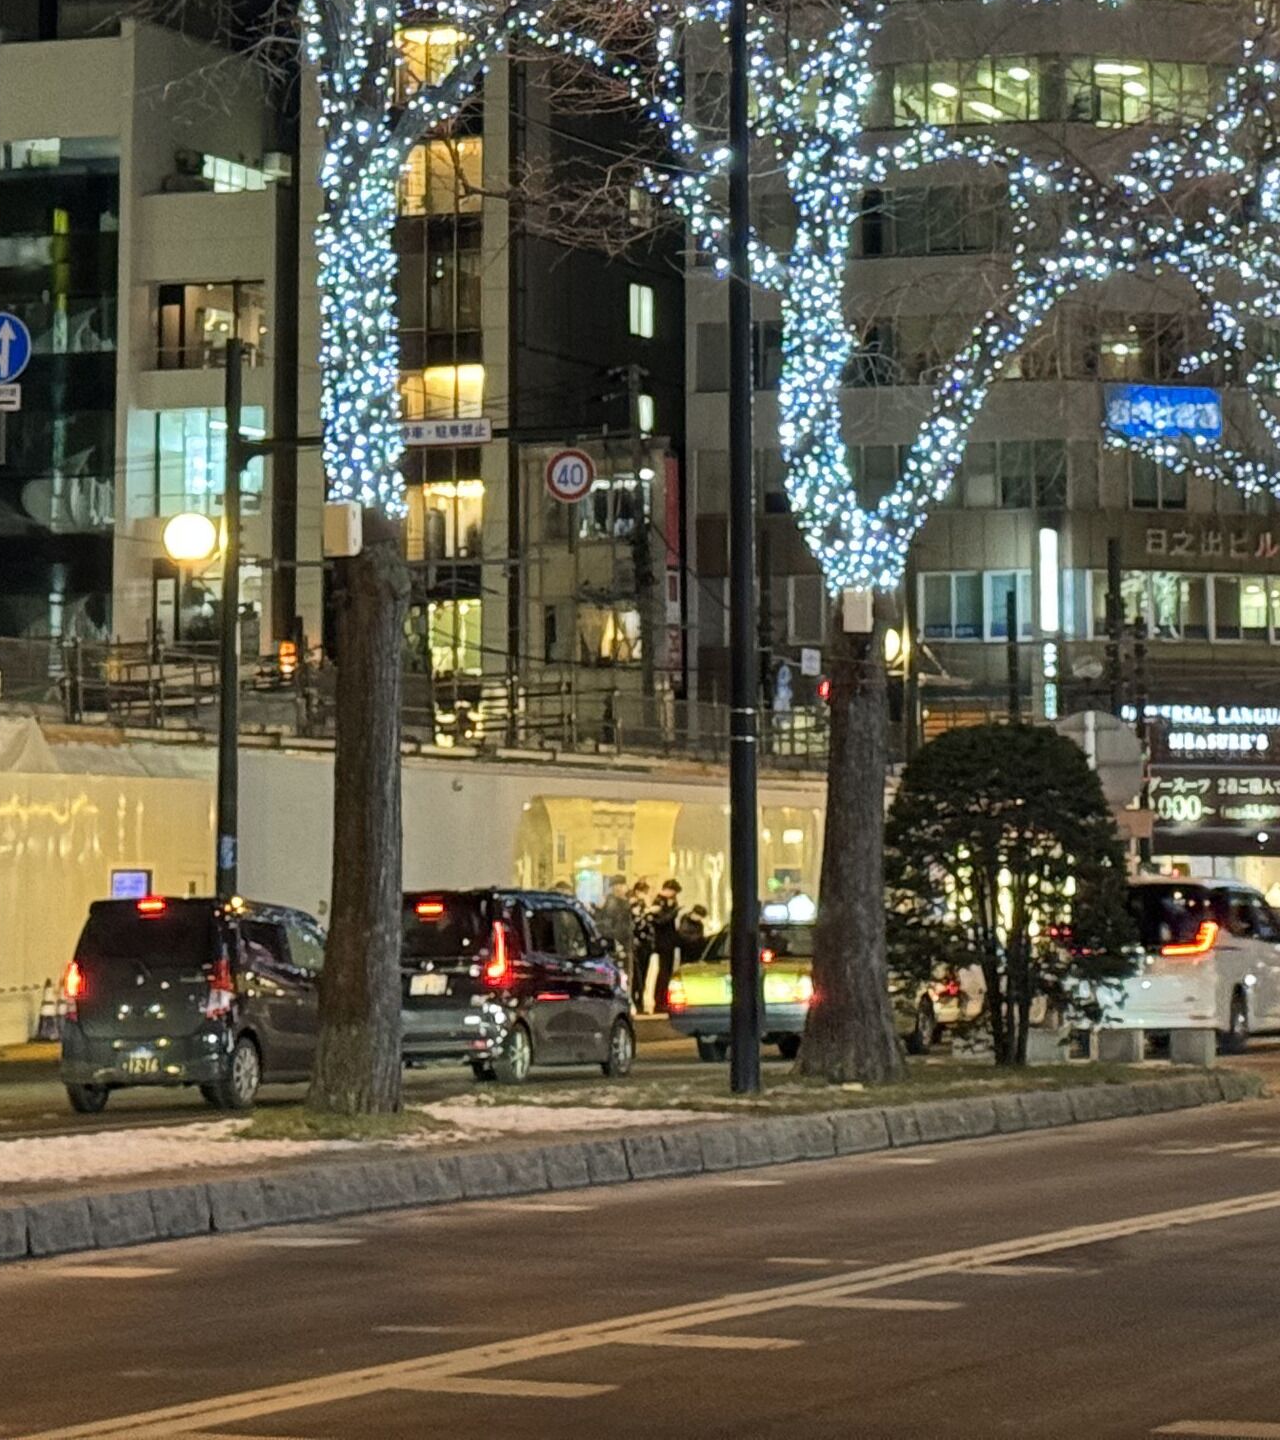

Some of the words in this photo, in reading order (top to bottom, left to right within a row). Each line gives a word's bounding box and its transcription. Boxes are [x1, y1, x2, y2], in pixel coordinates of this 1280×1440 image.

[557, 463, 584, 487] 40
[1145, 527, 1280, 558] 日之出ビル
[1168, 732, 1269, 751] MEASURE'S
